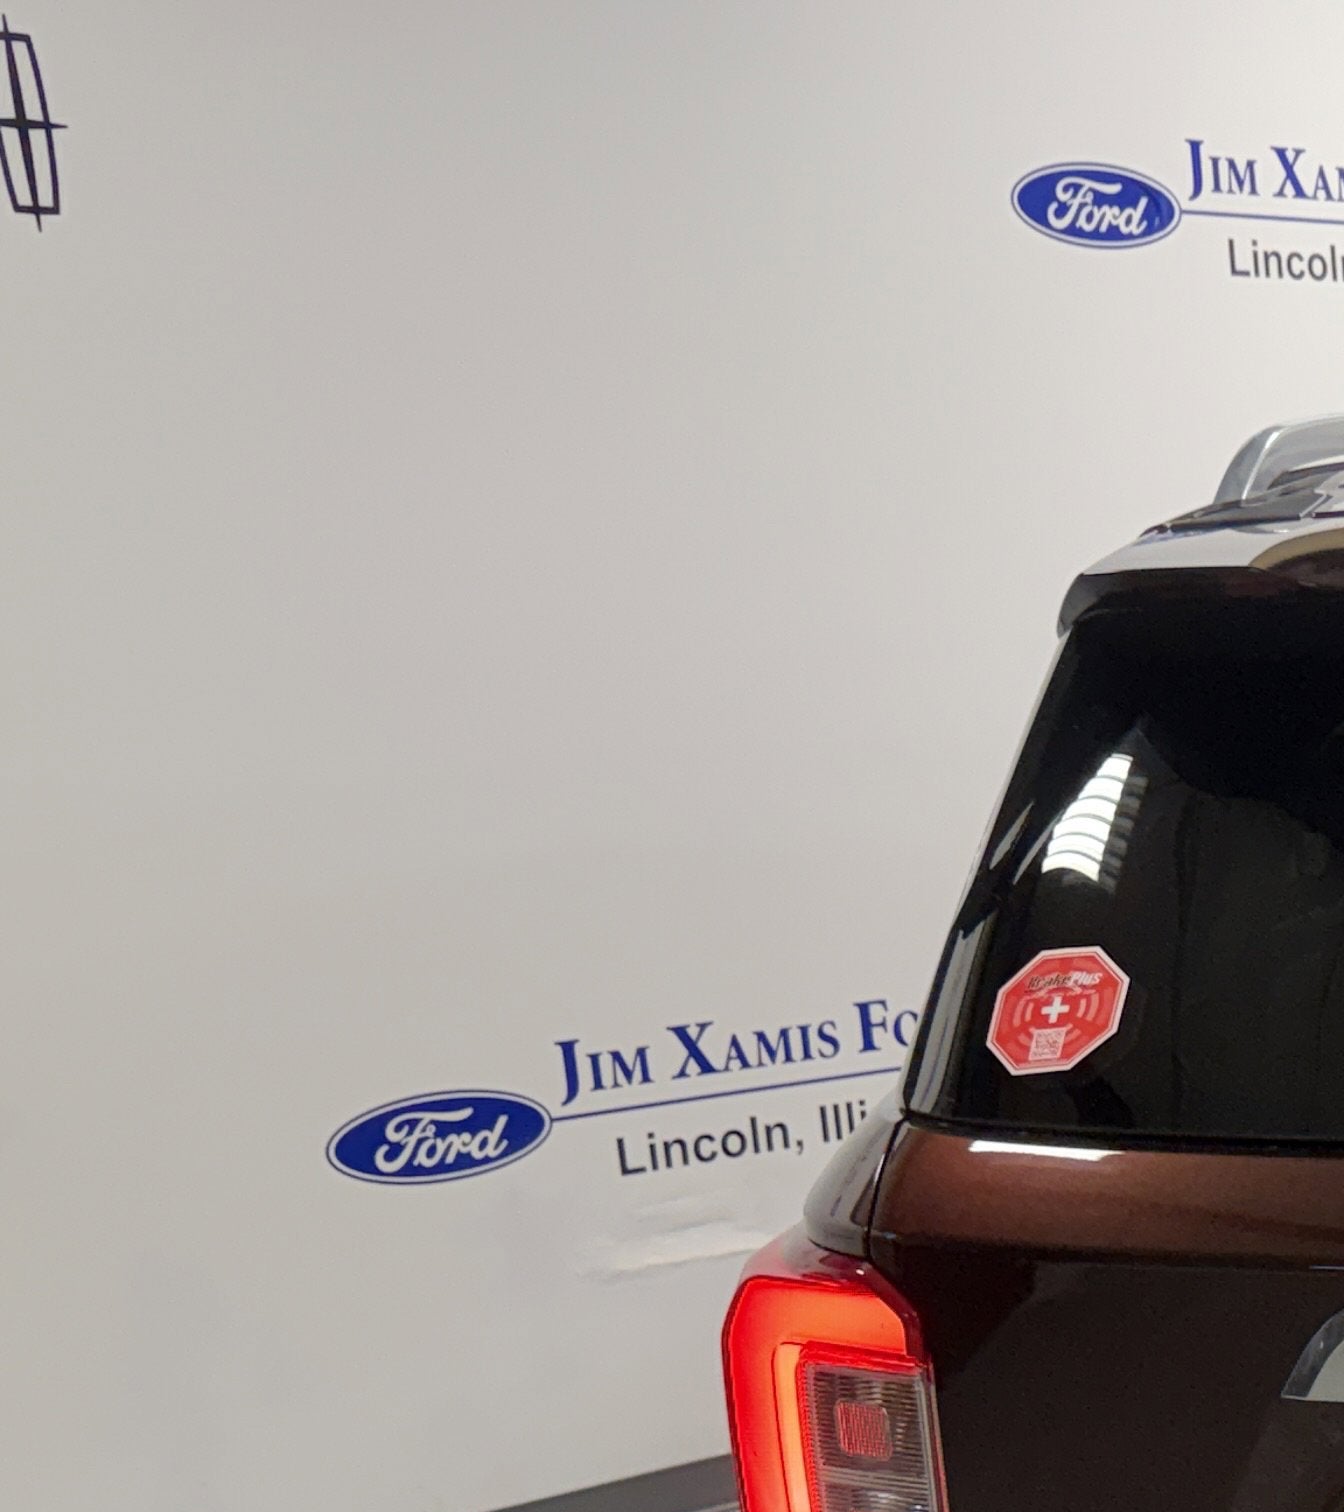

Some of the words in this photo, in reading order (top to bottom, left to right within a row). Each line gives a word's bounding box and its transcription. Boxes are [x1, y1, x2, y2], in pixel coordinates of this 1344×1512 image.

[1185, 139, 1258, 201] JIM
[1046, 175, 1147, 236] Ford
[554, 1039, 655, 1106] JIM
[666, 1019, 841, 1081] XAMIS
[853, 999, 918, 1053] FO
[374, 1107, 509, 1173] Ford
[617, 1114, 803, 1176] Lincoln,
